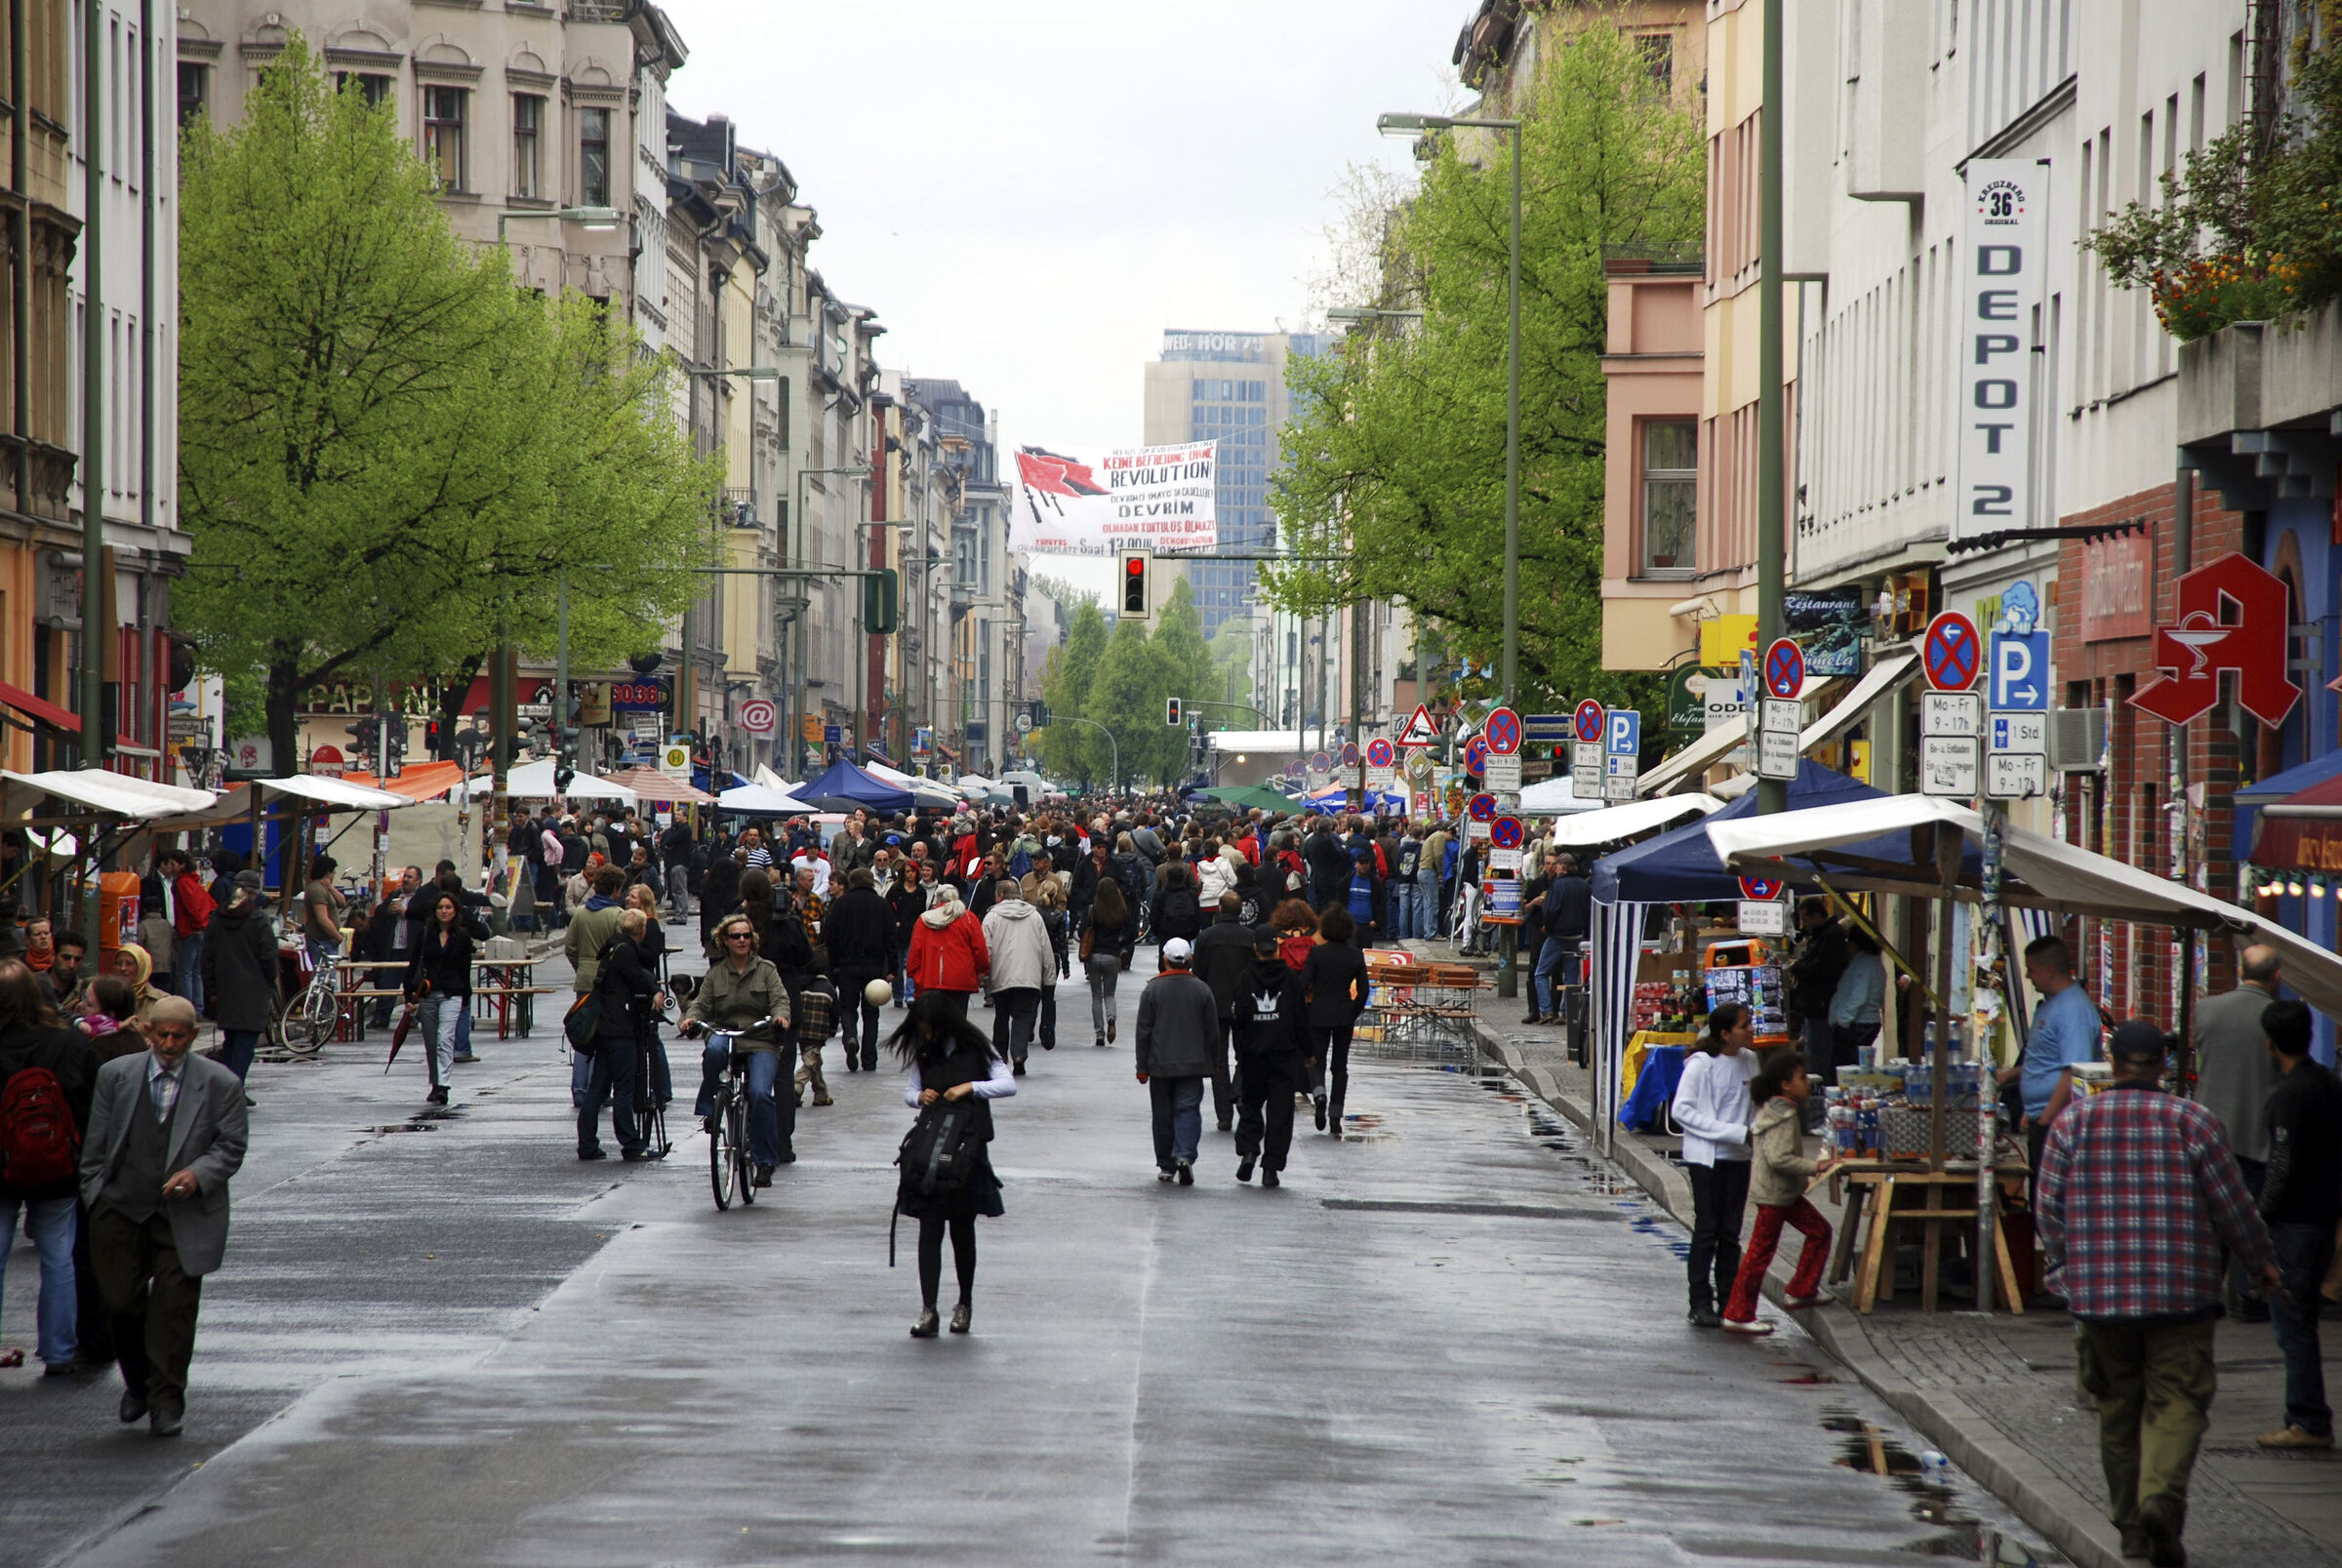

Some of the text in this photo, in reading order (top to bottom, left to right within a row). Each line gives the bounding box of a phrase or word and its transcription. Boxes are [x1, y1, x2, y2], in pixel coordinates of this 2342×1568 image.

[1978, 181, 2025, 203] KREUZBERG
[1991, 192, 2012, 217] 36
[1972, 244, 2023, 516] DEPOT 2
[1103, 446, 1214, 470] KEINE BEFREIUNG OHNE
[1110, 460, 1213, 488] REVOLUTION!
[1118, 499, 1194, 518] DEVRİM
[1079, 537, 1105, 555] Saat
[1784, 596, 1856, 610] Restaurant
[1999, 640, 2033, 705] P
[1770, 704, 1796, 714] Mo Fr
[1933, 698, 1949, 711] Mo
[1958, 698, 1970, 711] Fr
[1672, 712, 1706, 727] Elefan
[1771, 717, 1795, 728] 9 17h
[1934, 716, 1941, 730] 9
[1953, 717, 1969, 731] 17h
[1612, 716, 1631, 751] P
[1999, 759, 2014, 772] Mo
[2024, 758, 2037, 772] Fr
[1999, 778, 2006, 790] 9
[1253, 1012, 1280, 1022] BERLIN
